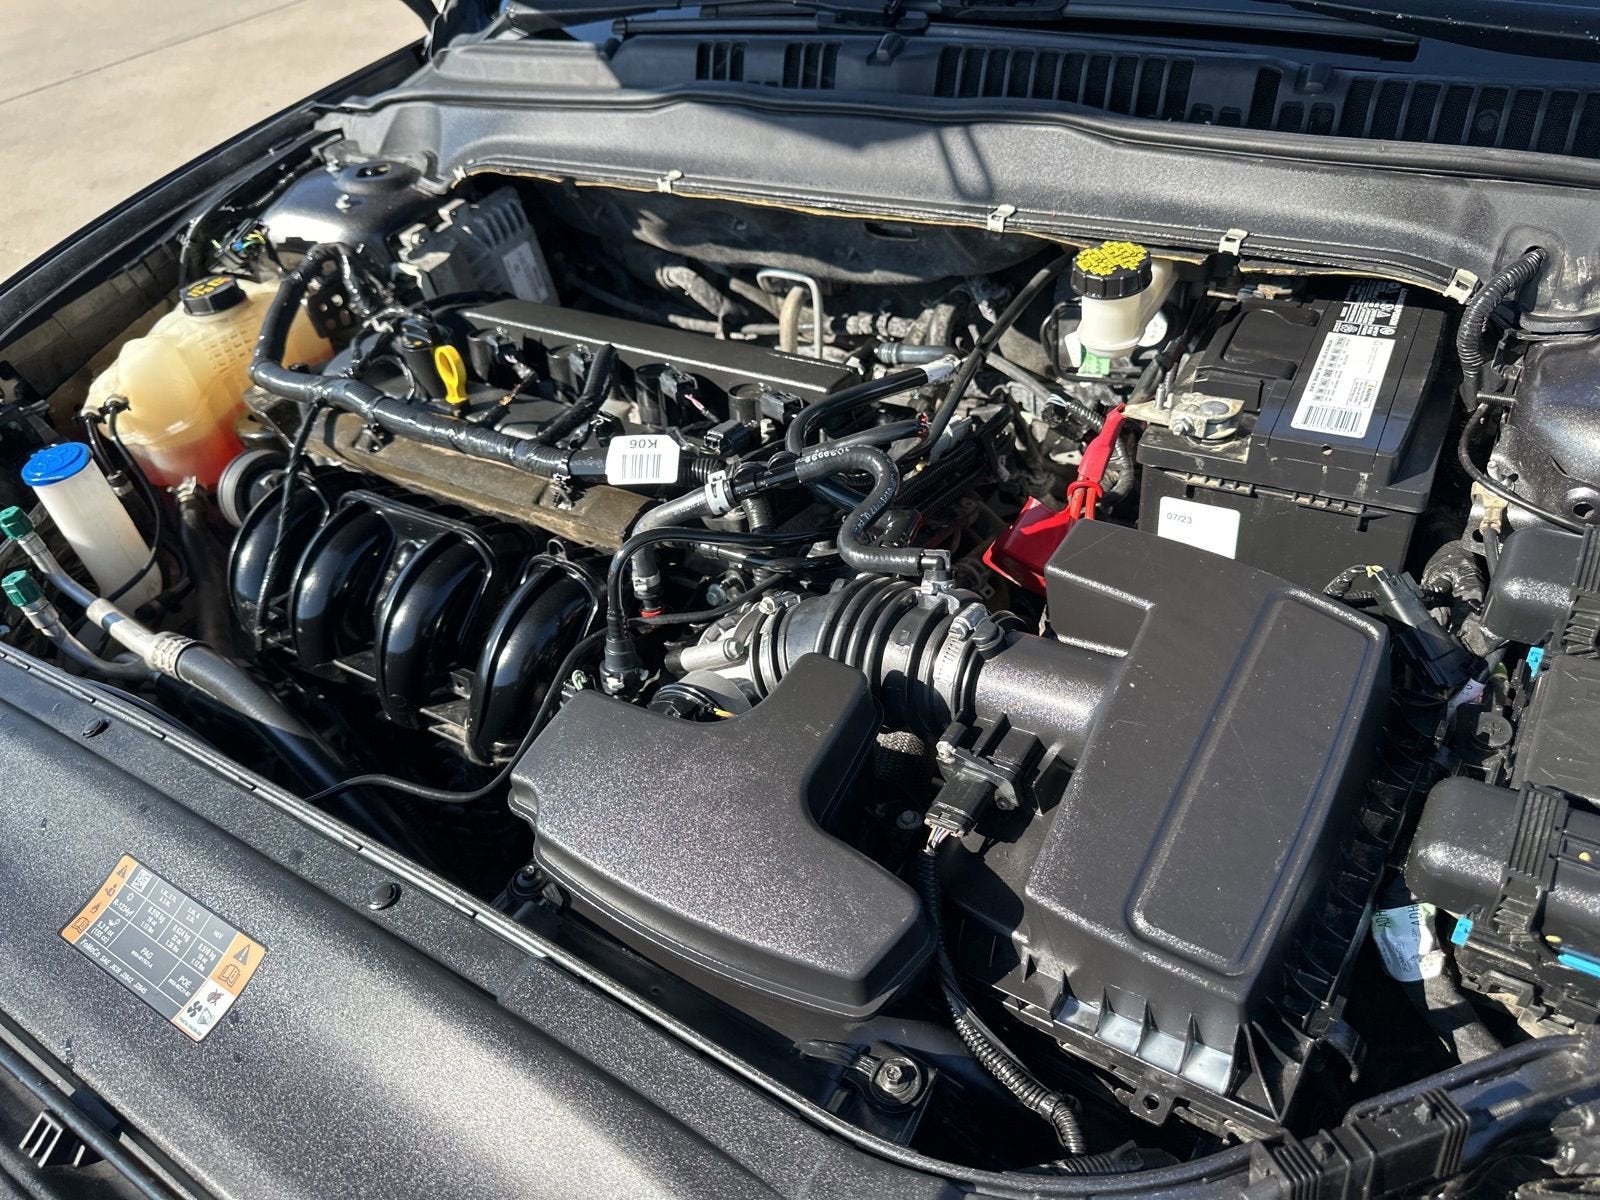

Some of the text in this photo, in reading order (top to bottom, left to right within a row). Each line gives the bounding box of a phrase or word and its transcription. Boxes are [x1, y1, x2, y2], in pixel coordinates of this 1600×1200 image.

[629, 439, 658, 449] K06
[1166, 512, 1193, 525] 07/23
[111, 898, 134, 918] R-1234yf
[96, 921, 105, 929] 5.2
[98, 933, 110, 944] cc)
[79, 938, 102, 958] FoMoCo
[99, 954, 110, 965] SAE
[139, 947, 153, 959] PAG
[177, 975, 191, 988] POE
